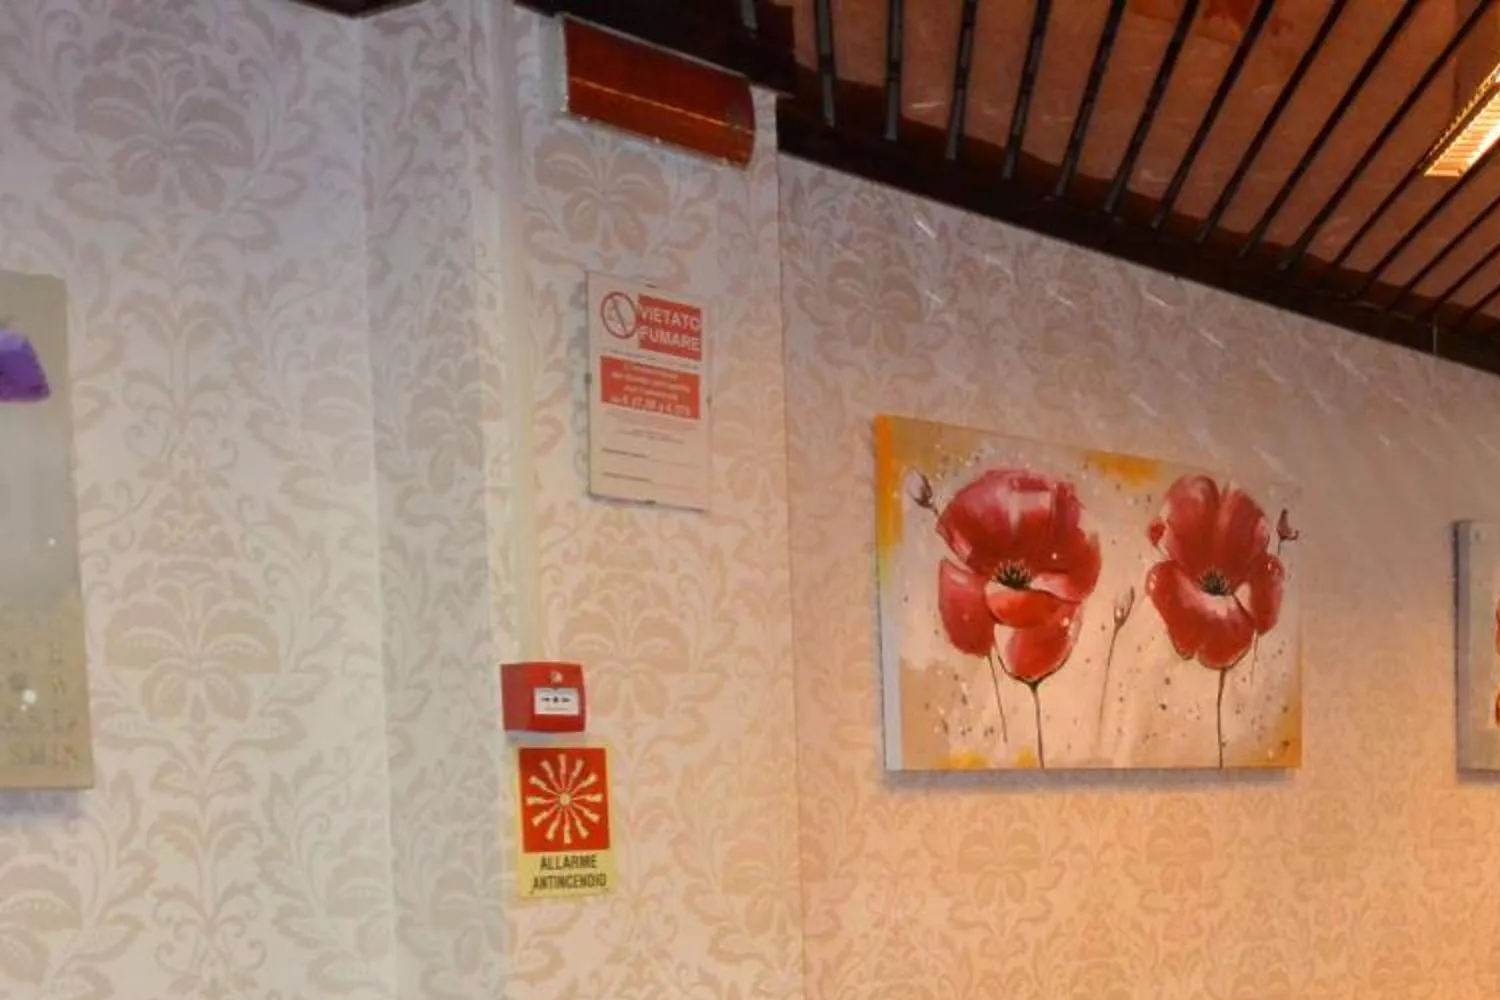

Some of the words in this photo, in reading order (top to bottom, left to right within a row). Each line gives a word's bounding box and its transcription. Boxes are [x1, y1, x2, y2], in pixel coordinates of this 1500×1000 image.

[639, 305, 700, 331] VIETATO
[639, 326, 700, 352] FUMARE
[540, 854, 597, 869] ALLARME
[533, 873, 607, 889] ANTINCENDIO
